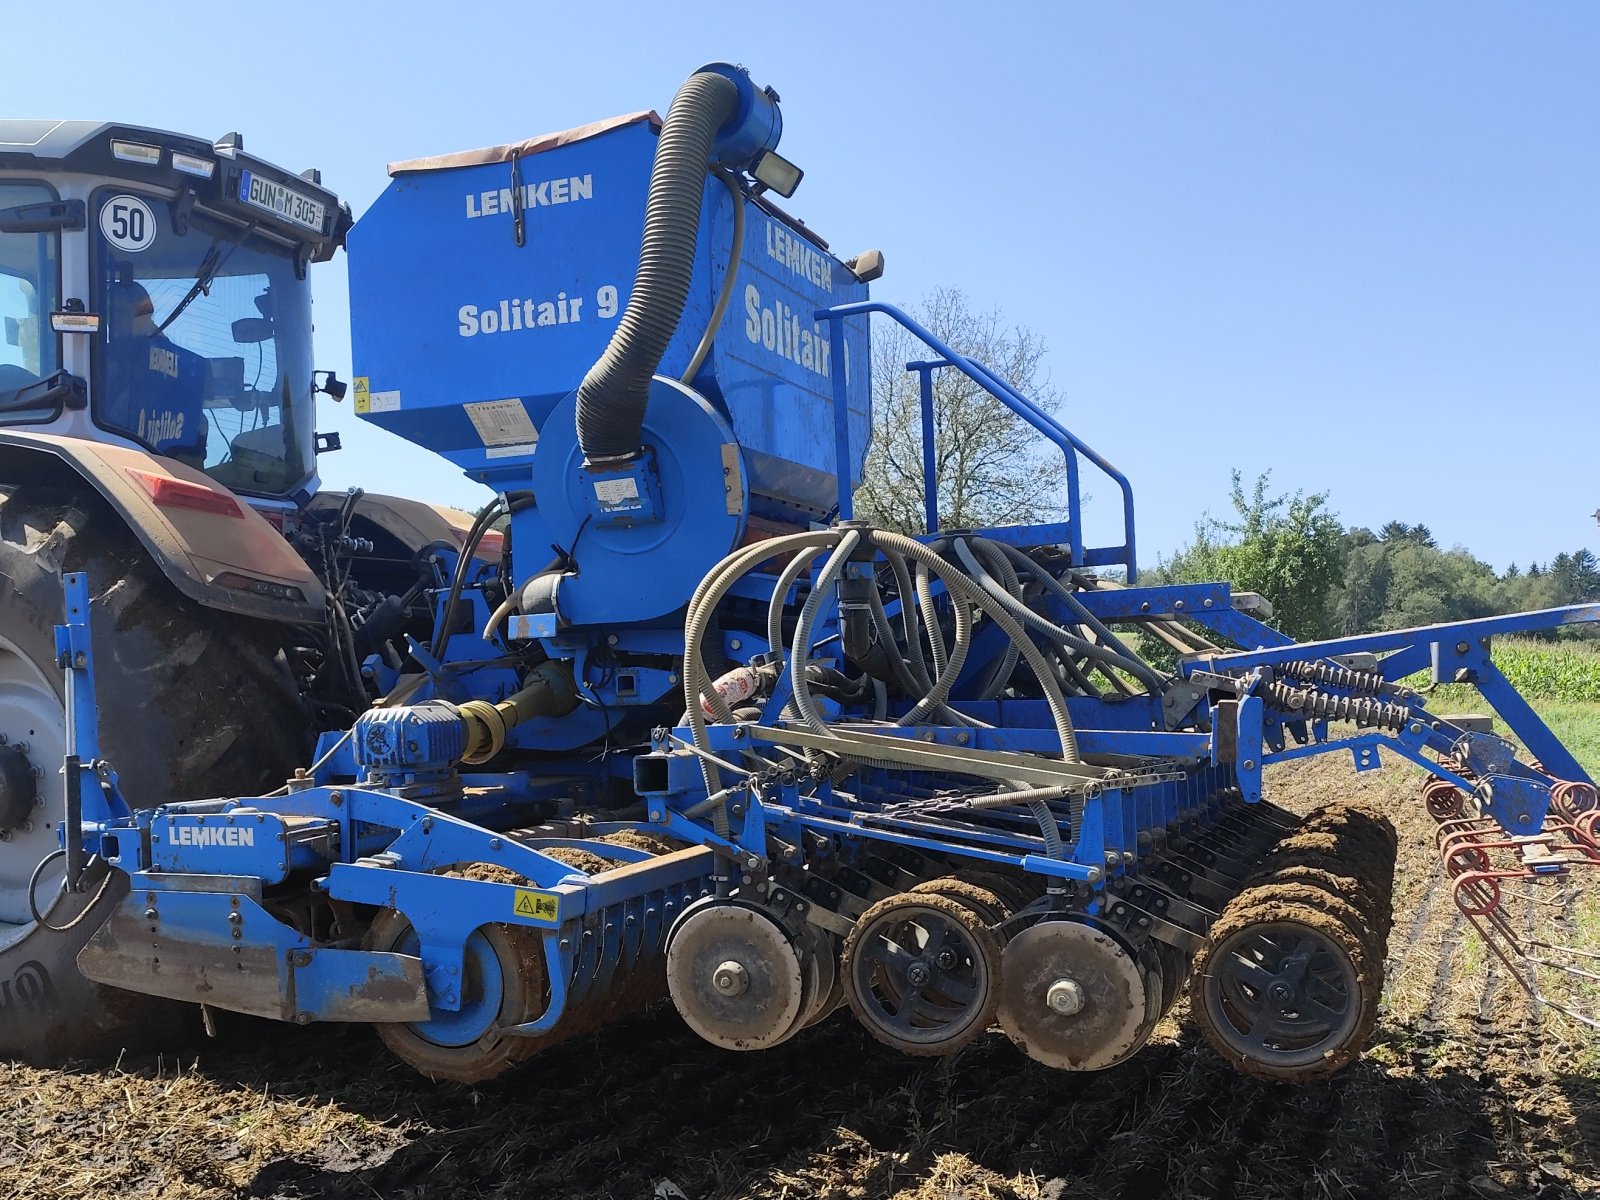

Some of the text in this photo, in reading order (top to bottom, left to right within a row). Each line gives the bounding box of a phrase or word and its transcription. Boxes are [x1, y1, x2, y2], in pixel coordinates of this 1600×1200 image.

[250, 178, 316, 225] GUN M 305
[466, 174, 593, 218] LEMKEN
[112, 204, 144, 242] 50
[766, 221, 832, 294] LEMKEN
[457, 285, 619, 337] Solitair 9
[744, 284, 830, 378] Solitair
[168, 826, 255, 851] LEMKEN
